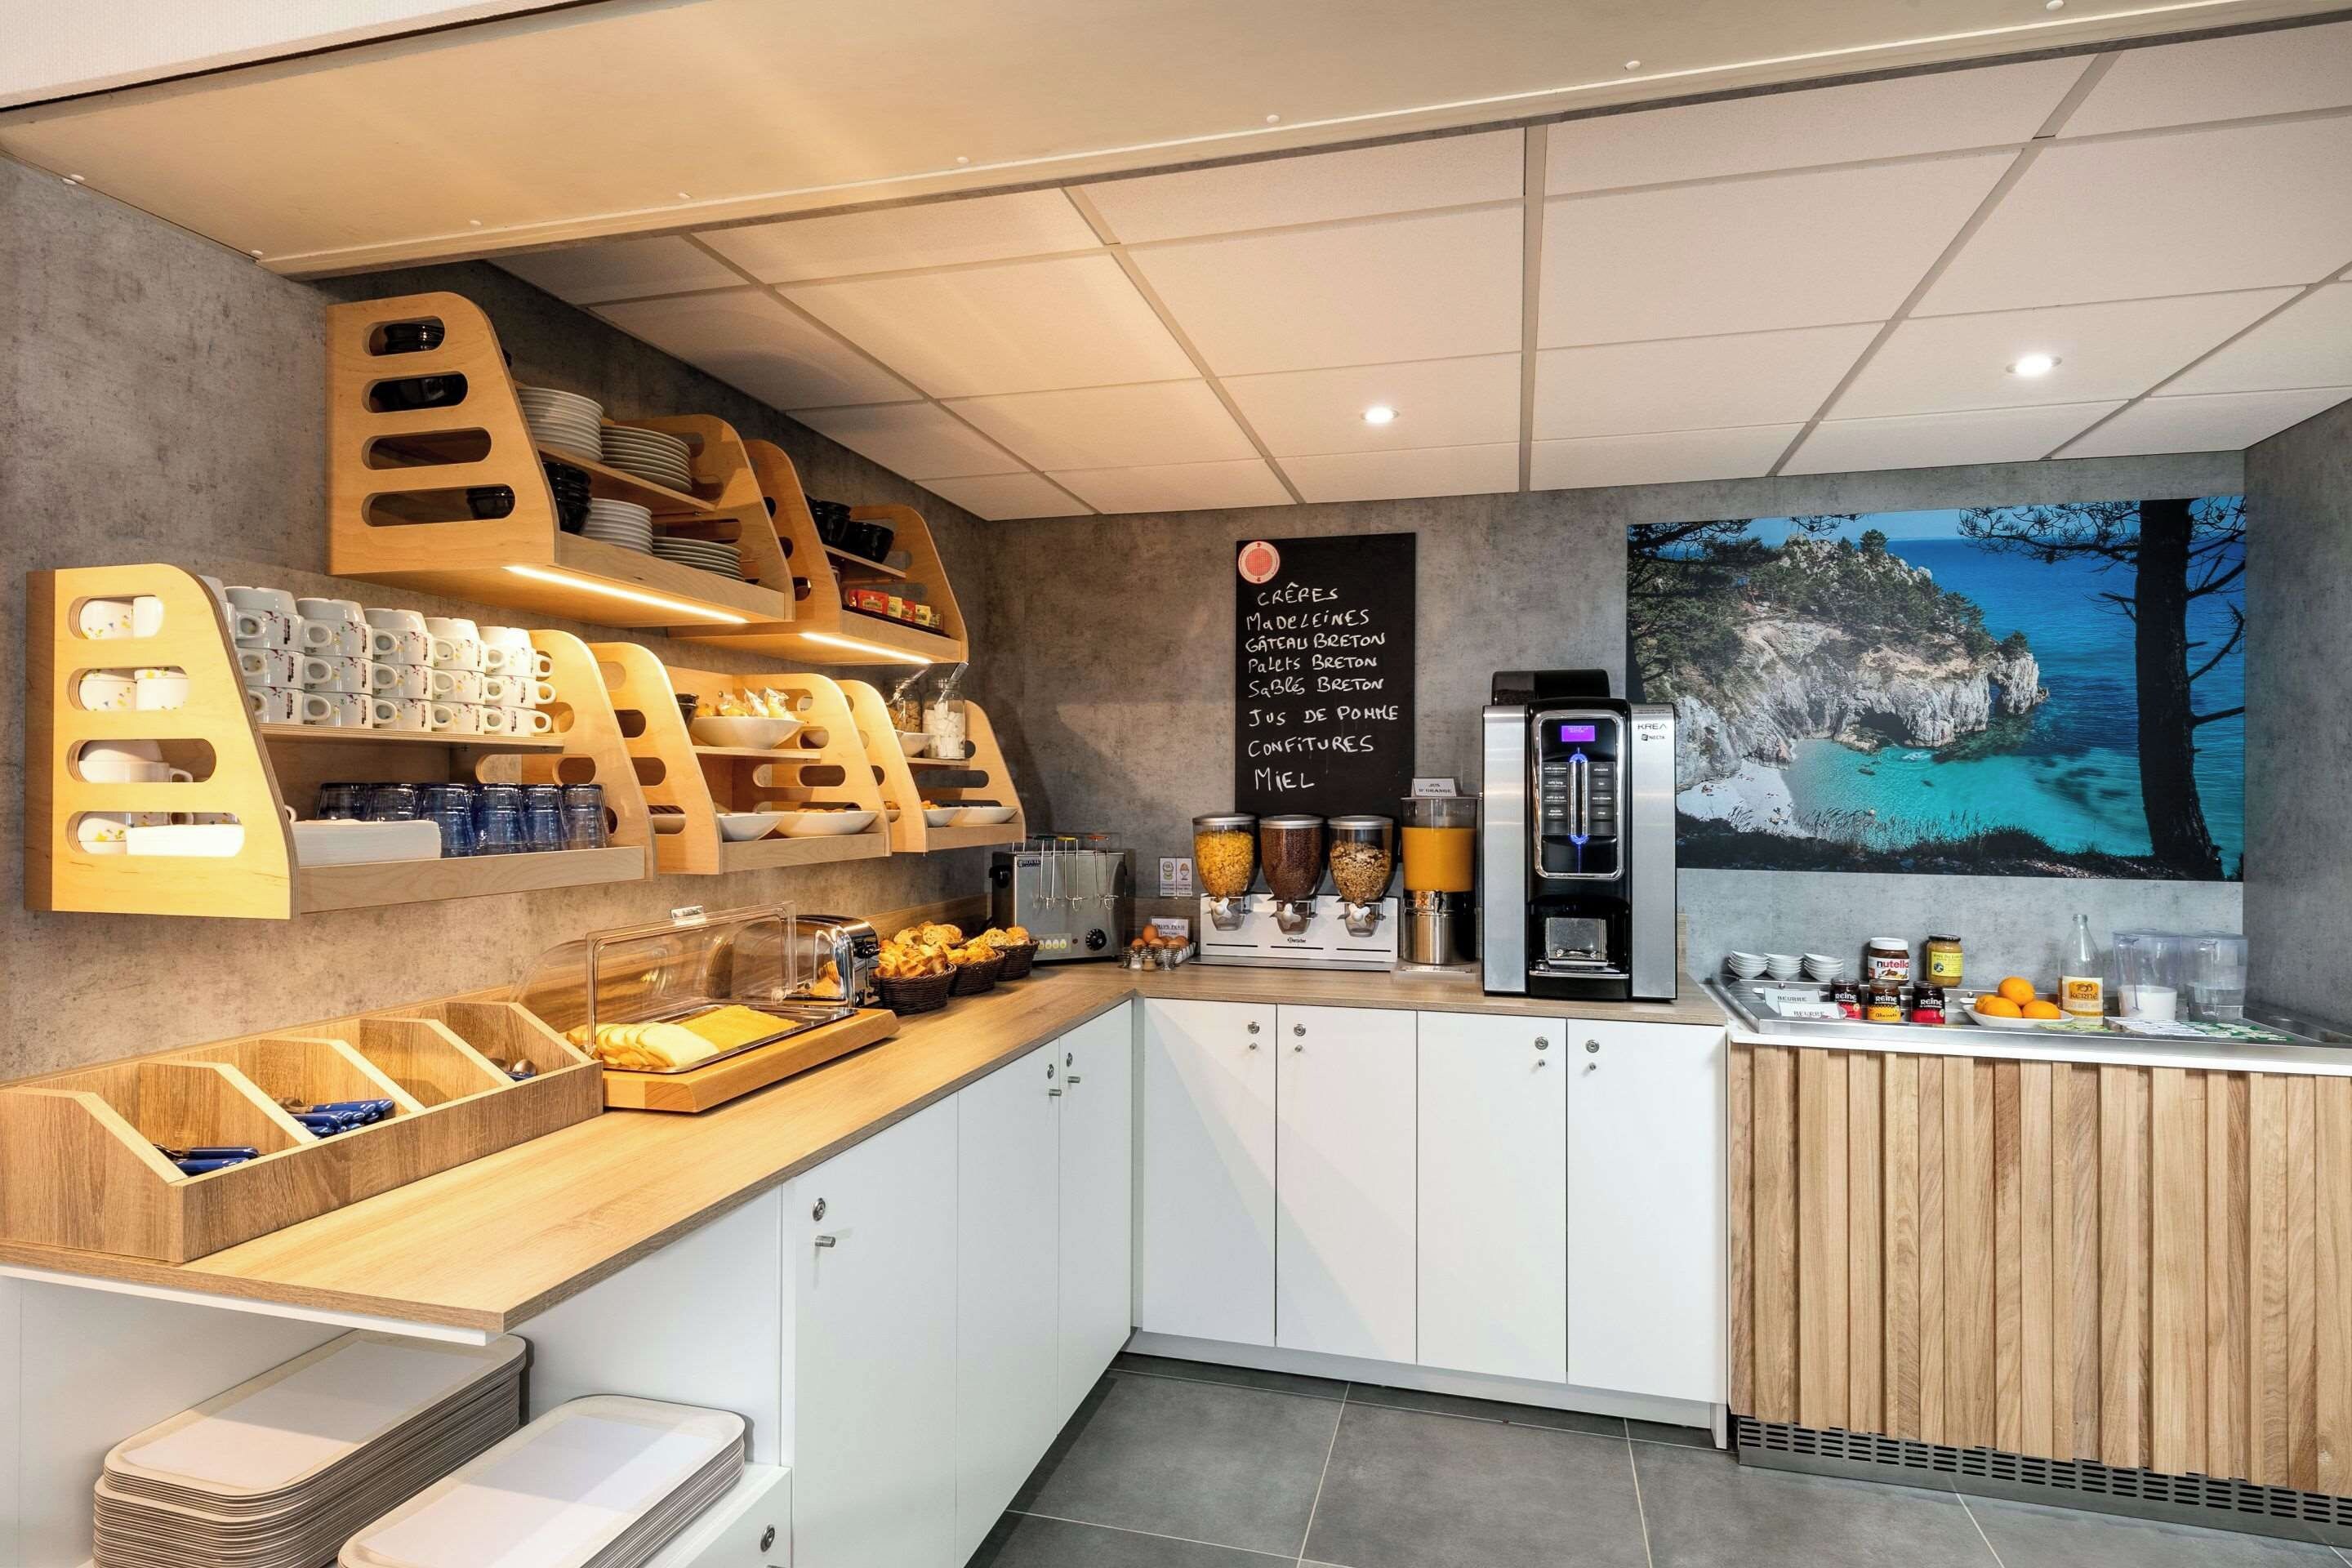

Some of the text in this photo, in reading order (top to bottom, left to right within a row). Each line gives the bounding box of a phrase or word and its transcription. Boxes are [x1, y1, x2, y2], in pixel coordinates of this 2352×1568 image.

[1245, 632, 1386, 653] GÂTEAU BRETON
[1312, 654, 1378, 670] BRETON
[1316, 676, 1385, 693] BRETON
[1303, 708, 1327, 724] DE
[1337, 705, 1399, 720] POMME
[1877, 960, 1909, 969] nutella
